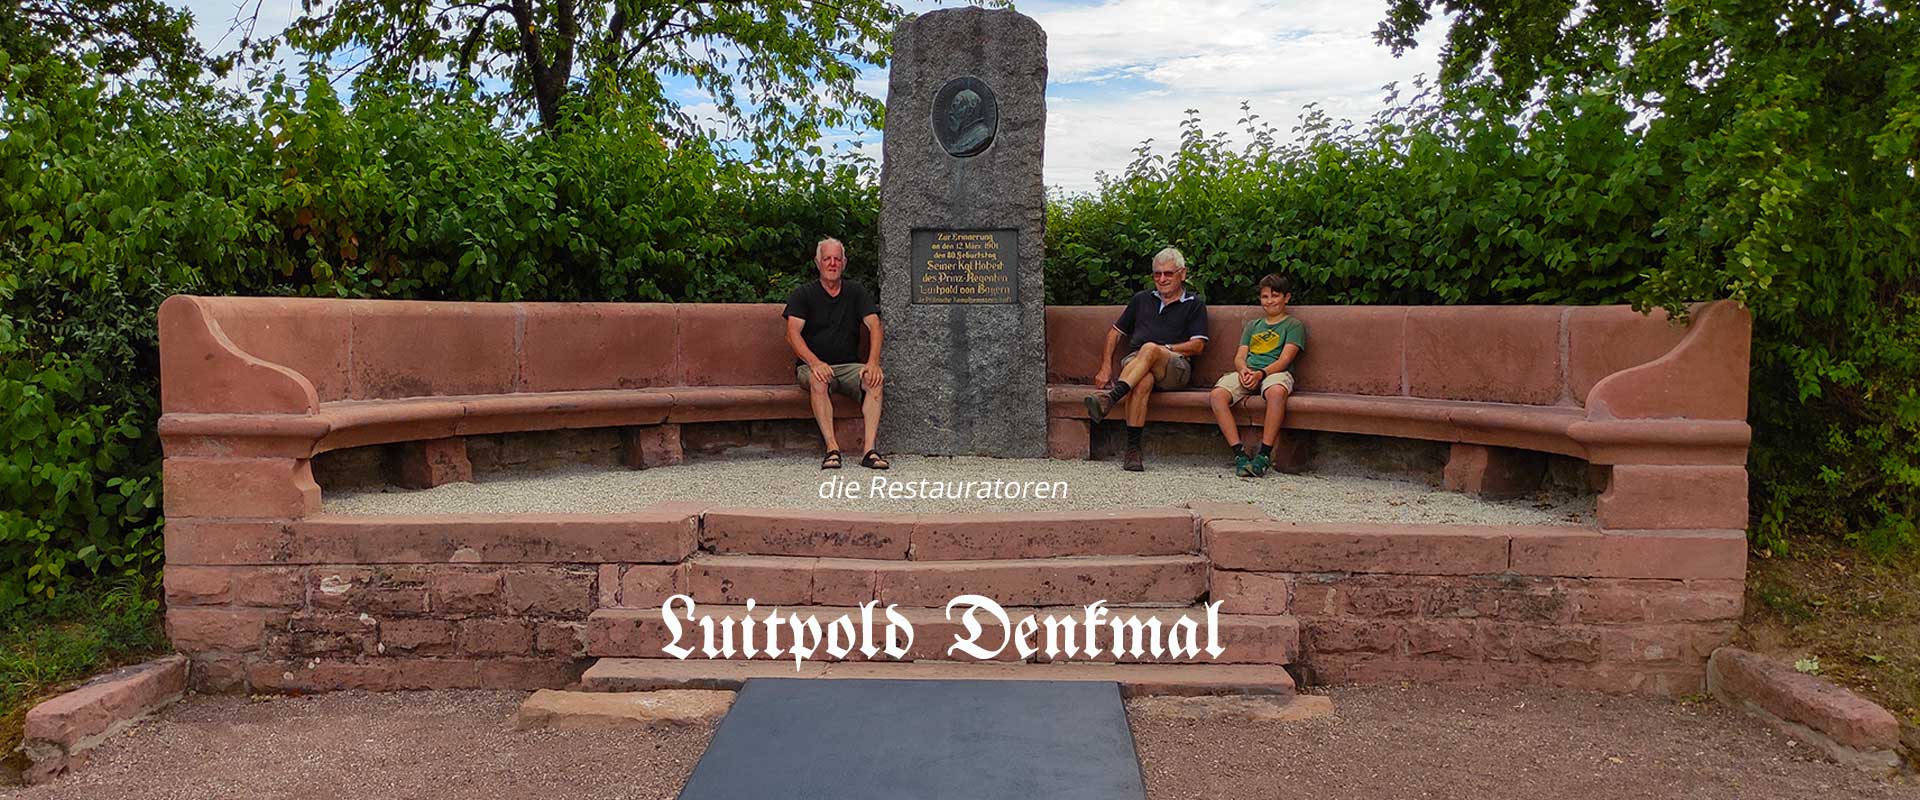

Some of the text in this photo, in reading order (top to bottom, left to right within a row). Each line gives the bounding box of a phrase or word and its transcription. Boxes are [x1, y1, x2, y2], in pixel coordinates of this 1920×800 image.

[937, 232, 994, 242] Zur Erinnerung
[942, 242, 955, 250] den
[933, 251, 946, 260] den
[956, 251, 997, 261] Geburtstag
[927, 260, 957, 270] Seiner
[922, 272, 938, 283] des
[919, 285, 958, 295] Luitpold
[977, 283, 1011, 297] Bayern
